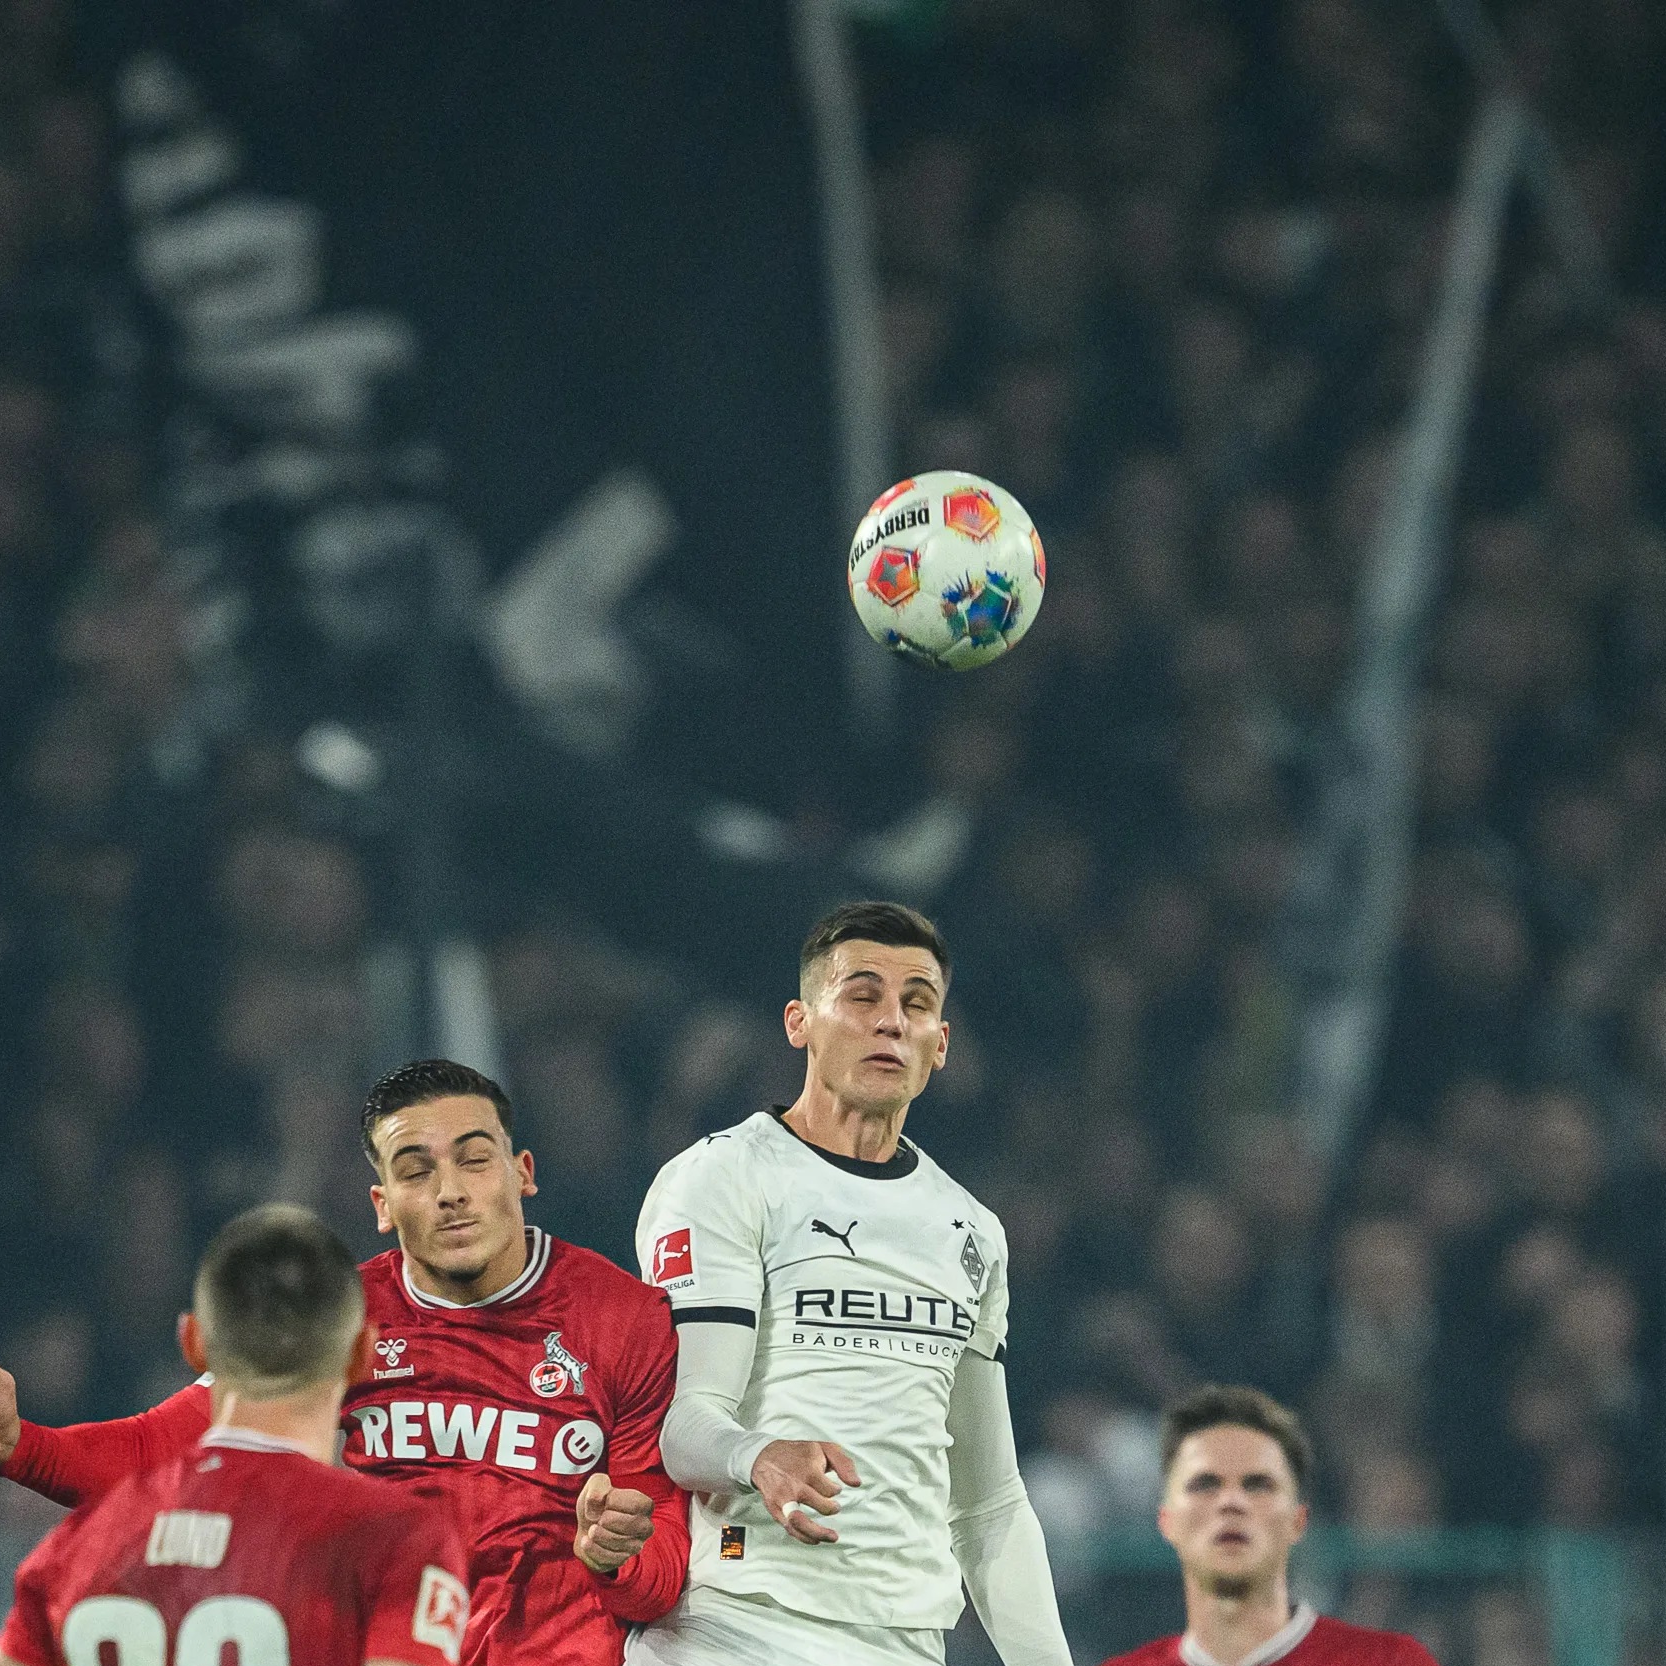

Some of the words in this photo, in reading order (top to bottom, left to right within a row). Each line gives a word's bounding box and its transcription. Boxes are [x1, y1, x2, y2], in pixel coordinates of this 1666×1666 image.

[795, 1288, 977, 1337] REUTE
[792, 1331, 881, 1350] BÄDER
[901, 1340, 964, 1359] LEUCH
[351, 1402, 540, 1471] REWE
